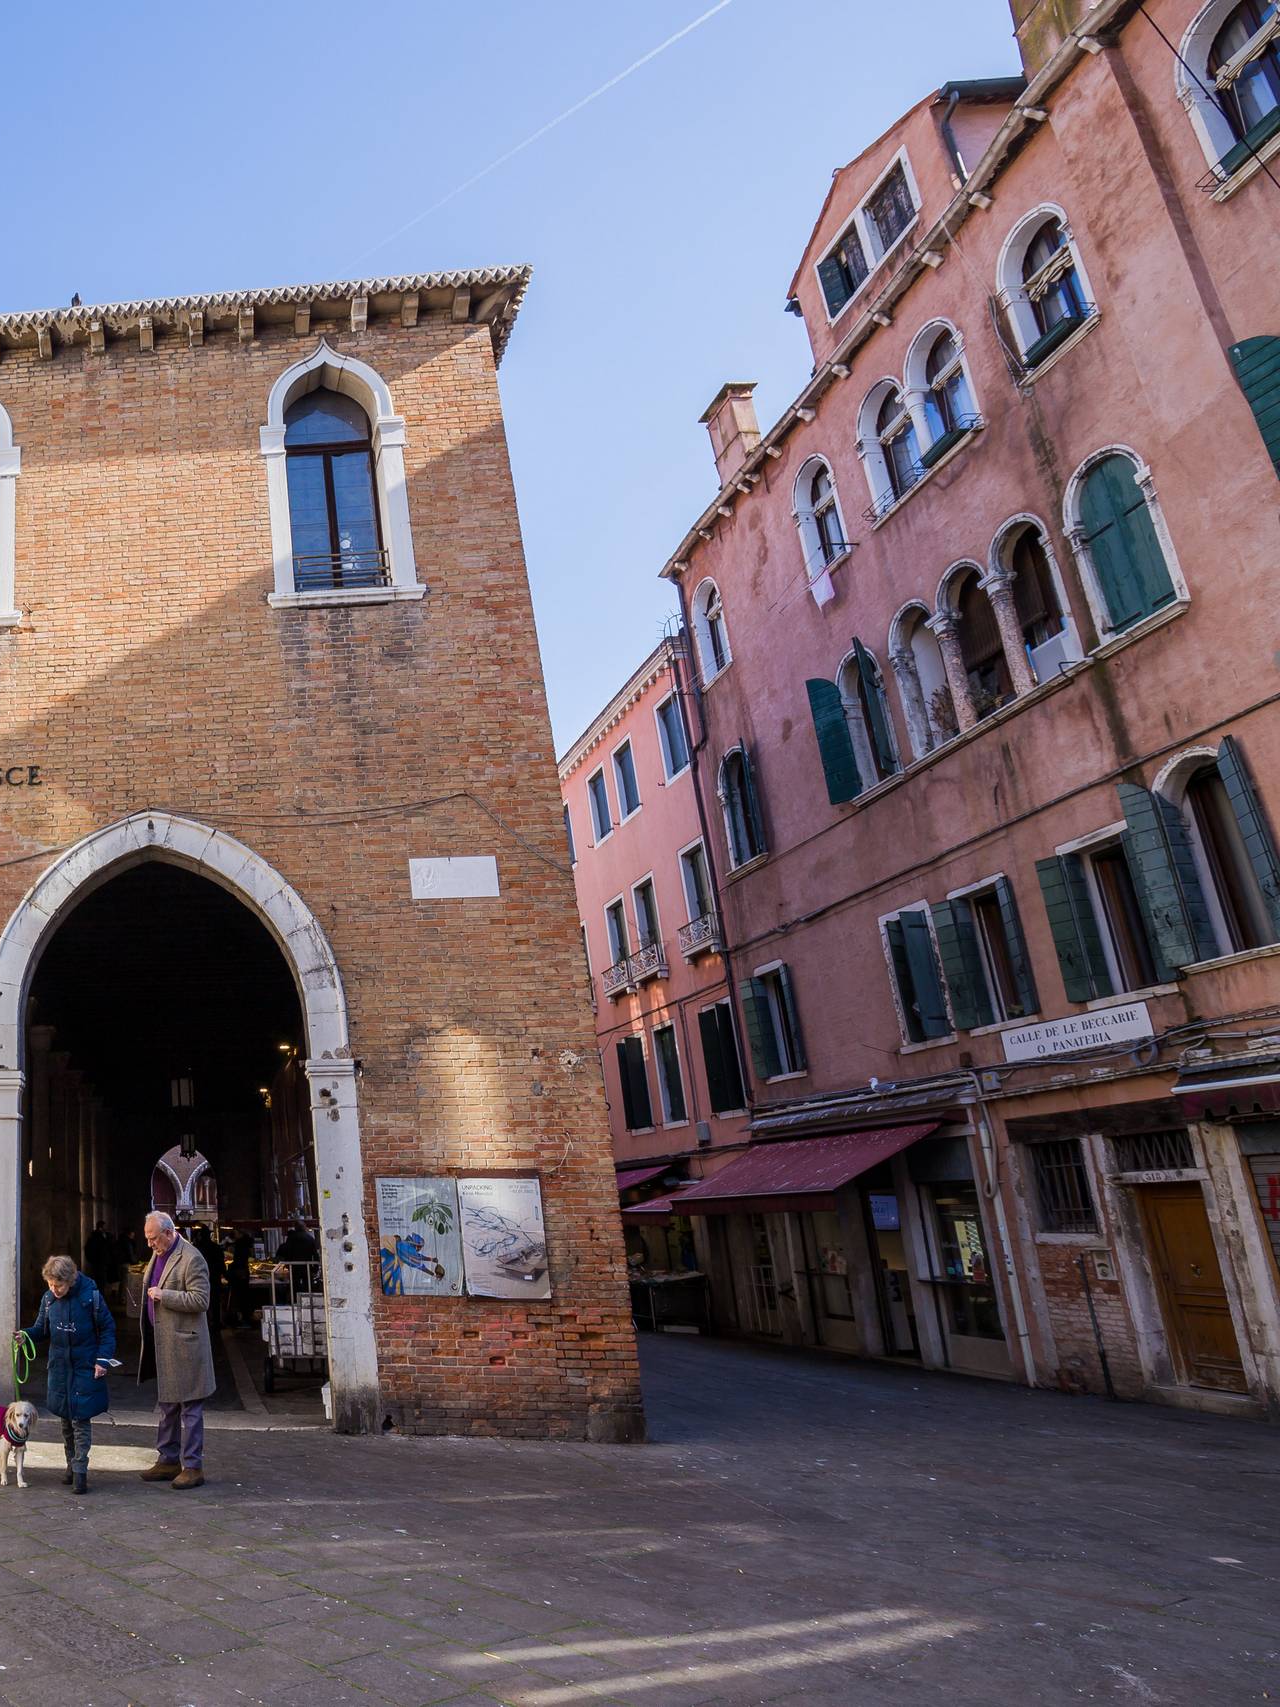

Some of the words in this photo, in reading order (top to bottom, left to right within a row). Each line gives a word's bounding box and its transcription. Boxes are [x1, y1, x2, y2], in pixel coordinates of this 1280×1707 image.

[1010, 1030, 1042, 1045] CALLE
[1045, 1026, 1060, 1038] DE
[1063, 1022, 1079, 1034] LE
[1081, 1010, 1139, 1031] BECCARIE
[1037, 1044, 1046, 1054] O
[1053, 1031, 1112, 1051] PANATERIA
